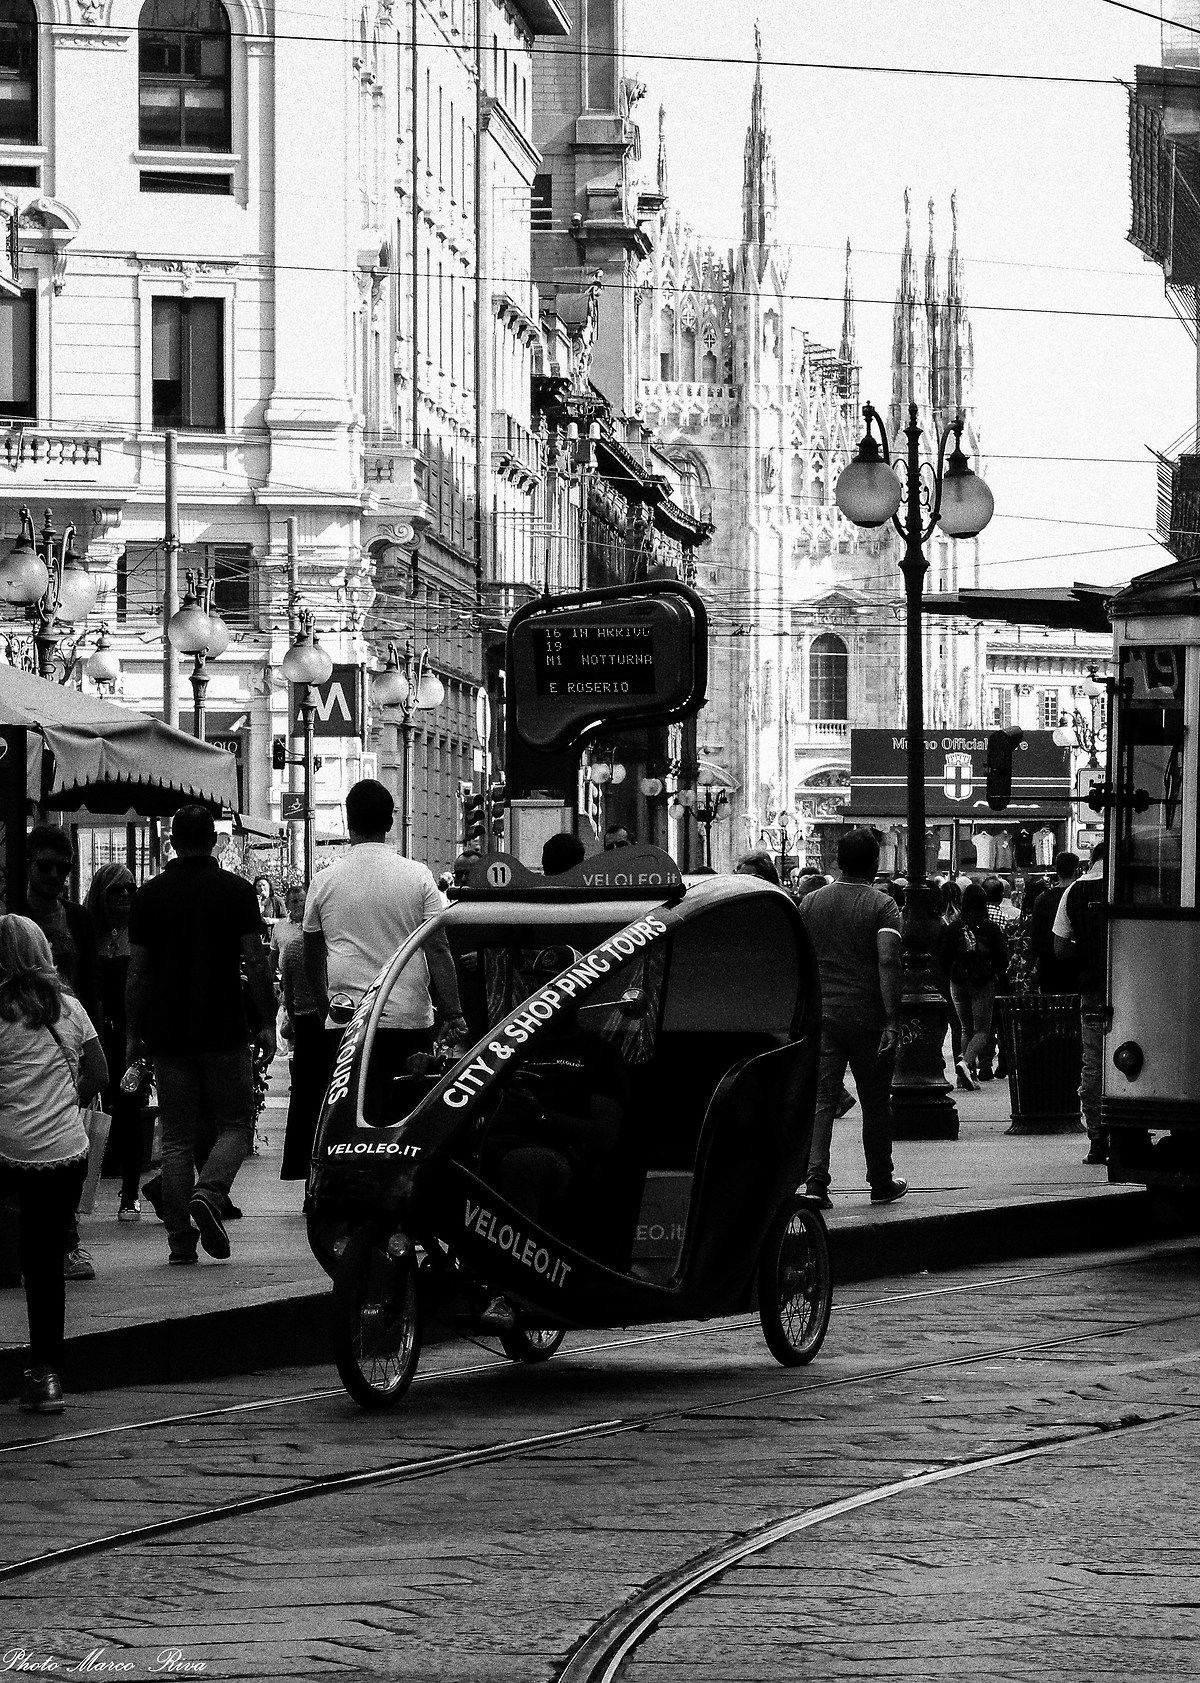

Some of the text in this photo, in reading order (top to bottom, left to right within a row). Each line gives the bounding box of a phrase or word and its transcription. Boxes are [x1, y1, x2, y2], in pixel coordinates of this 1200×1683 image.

[545, 628, 561, 638] 16
[546, 641, 562, 652] 19
[581, 654, 653, 665] NOTTURNA
[567, 681, 629, 693] ROSERIO
[296, 682, 352, 721] M
[941, 737, 989, 750] Official
[492, 866, 506, 883] 11
[443, 1056, 496, 1109] CITY
[488, 1041, 516, 1061] &
[600, 915, 668, 962] TOURS
[327, 1030, 360, 1106] TOURS
[326, 1143, 421, 1158] VELOLEO.IT
[464, 1200, 572, 1288] VELOLEO.IT
